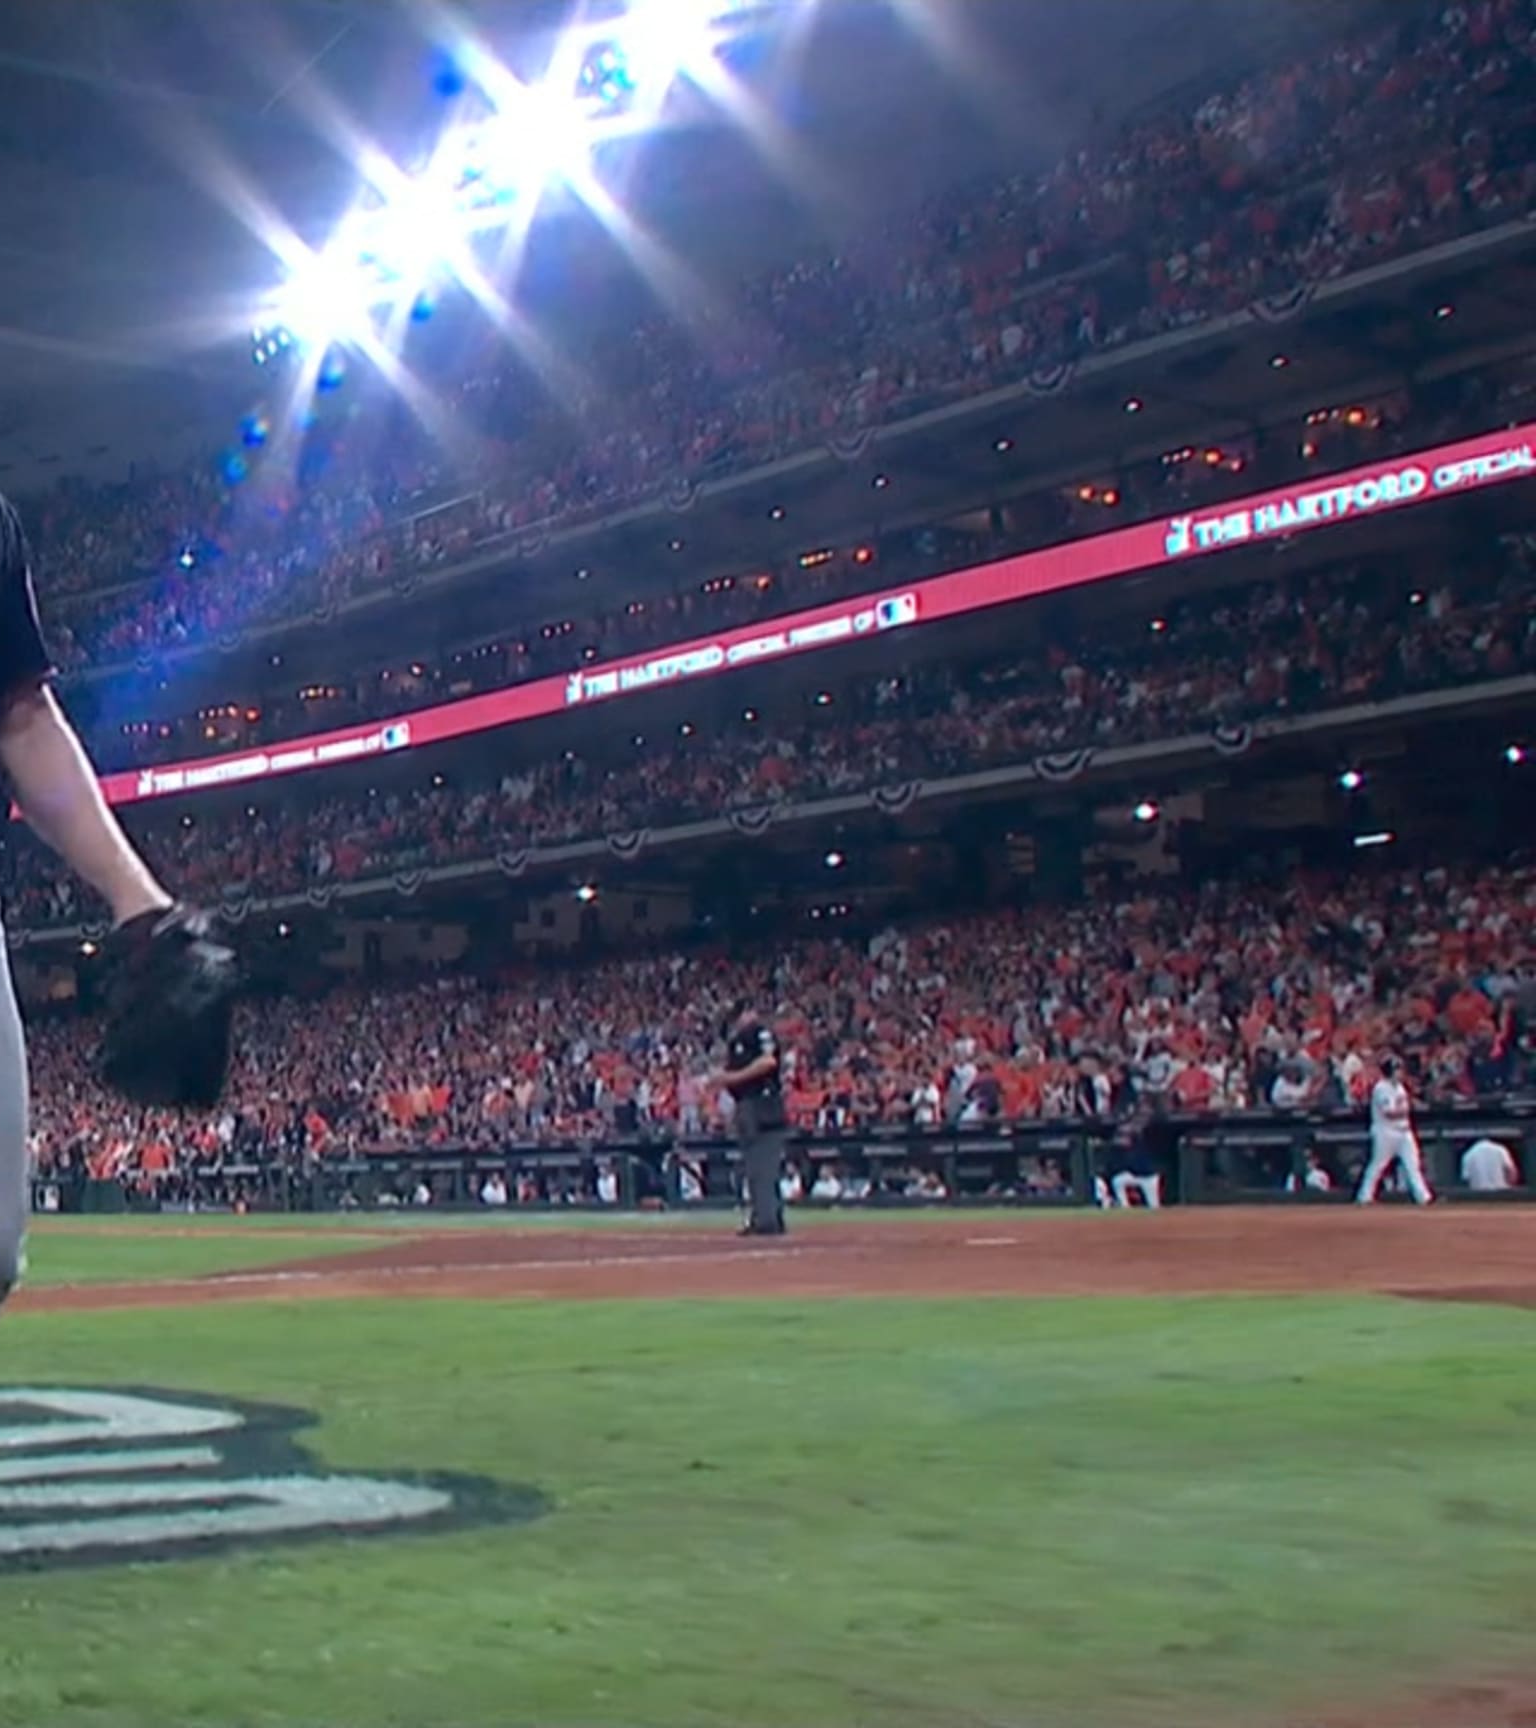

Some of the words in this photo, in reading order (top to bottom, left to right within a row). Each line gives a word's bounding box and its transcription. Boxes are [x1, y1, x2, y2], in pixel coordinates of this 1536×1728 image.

[1194, 511, 1250, 546] THE
[1253, 467, 1426, 533] HARTFORD
[1433, 444, 1536, 489] OFFICIAL
[584, 671, 618, 699] THE
[620, 644, 725, 690] HARTFORD
